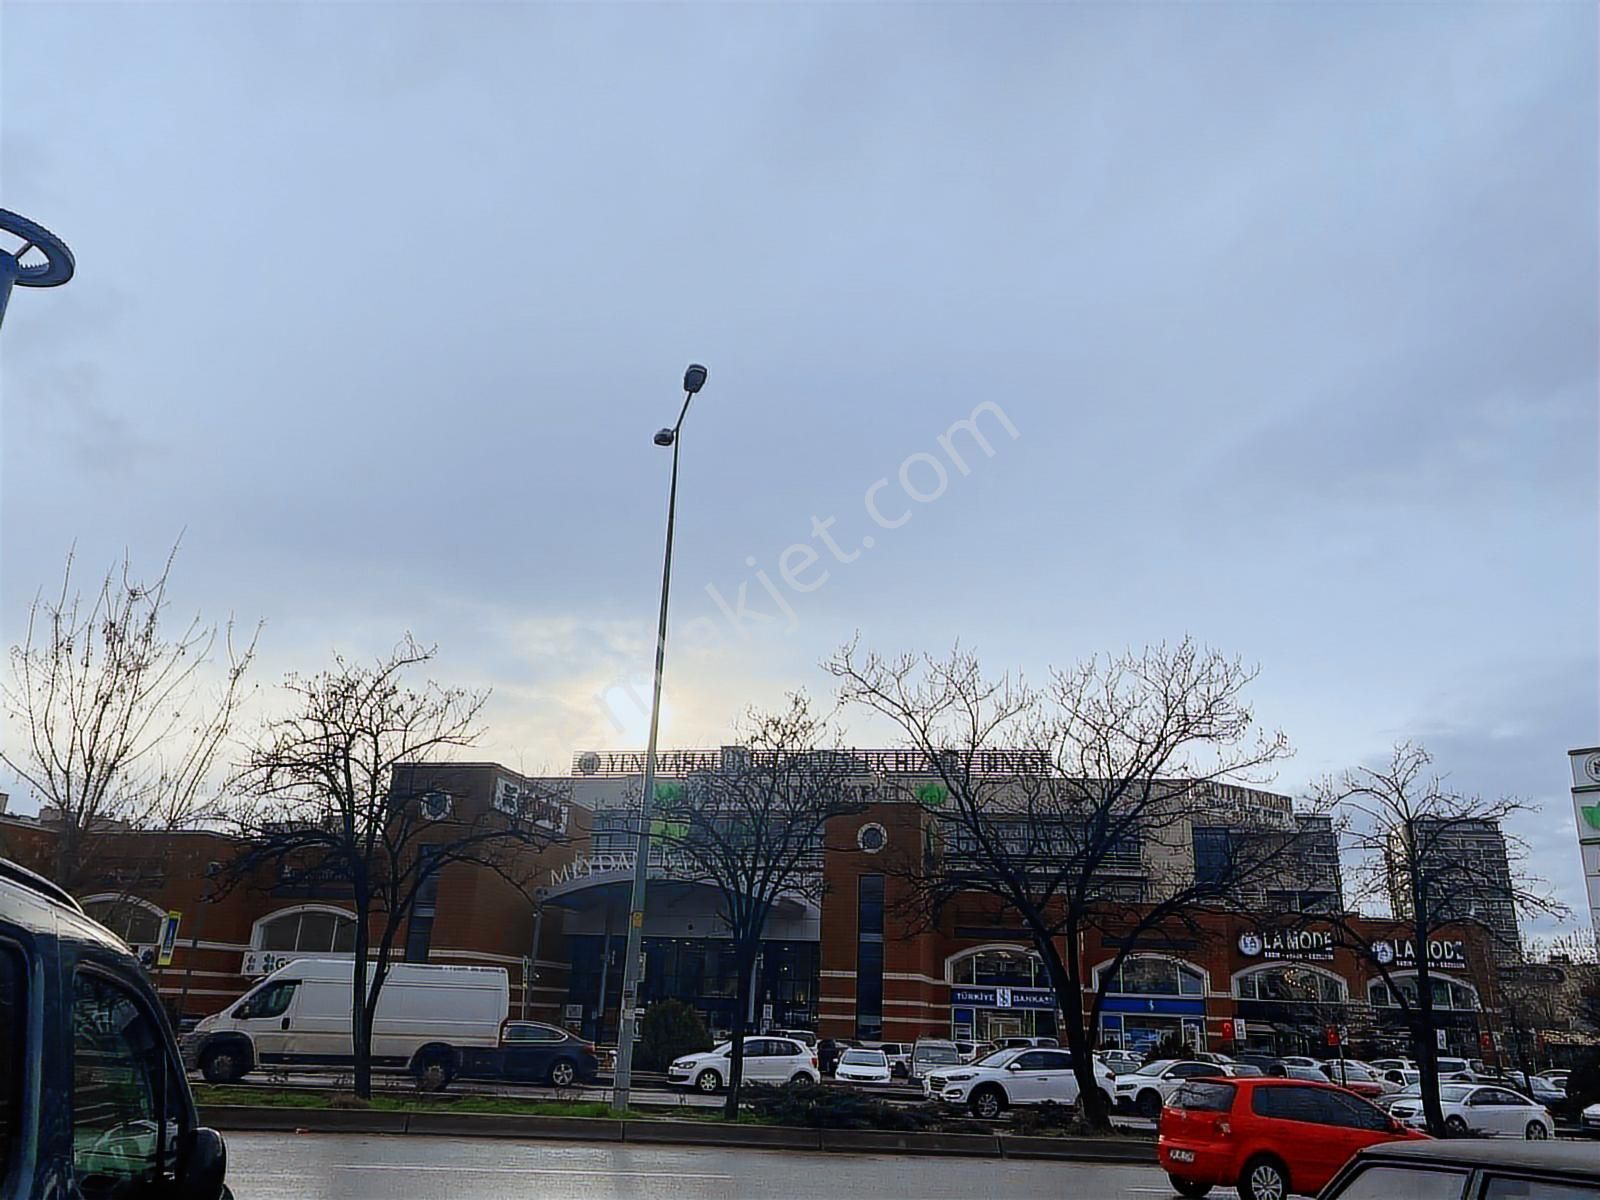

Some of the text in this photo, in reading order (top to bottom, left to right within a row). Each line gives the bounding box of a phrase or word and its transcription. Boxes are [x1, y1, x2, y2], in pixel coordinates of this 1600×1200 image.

[1263, 931, 1284, 950] LA
[1394, 938, 1416, 959] LA
[1426, 940, 1464, 961] ODE
